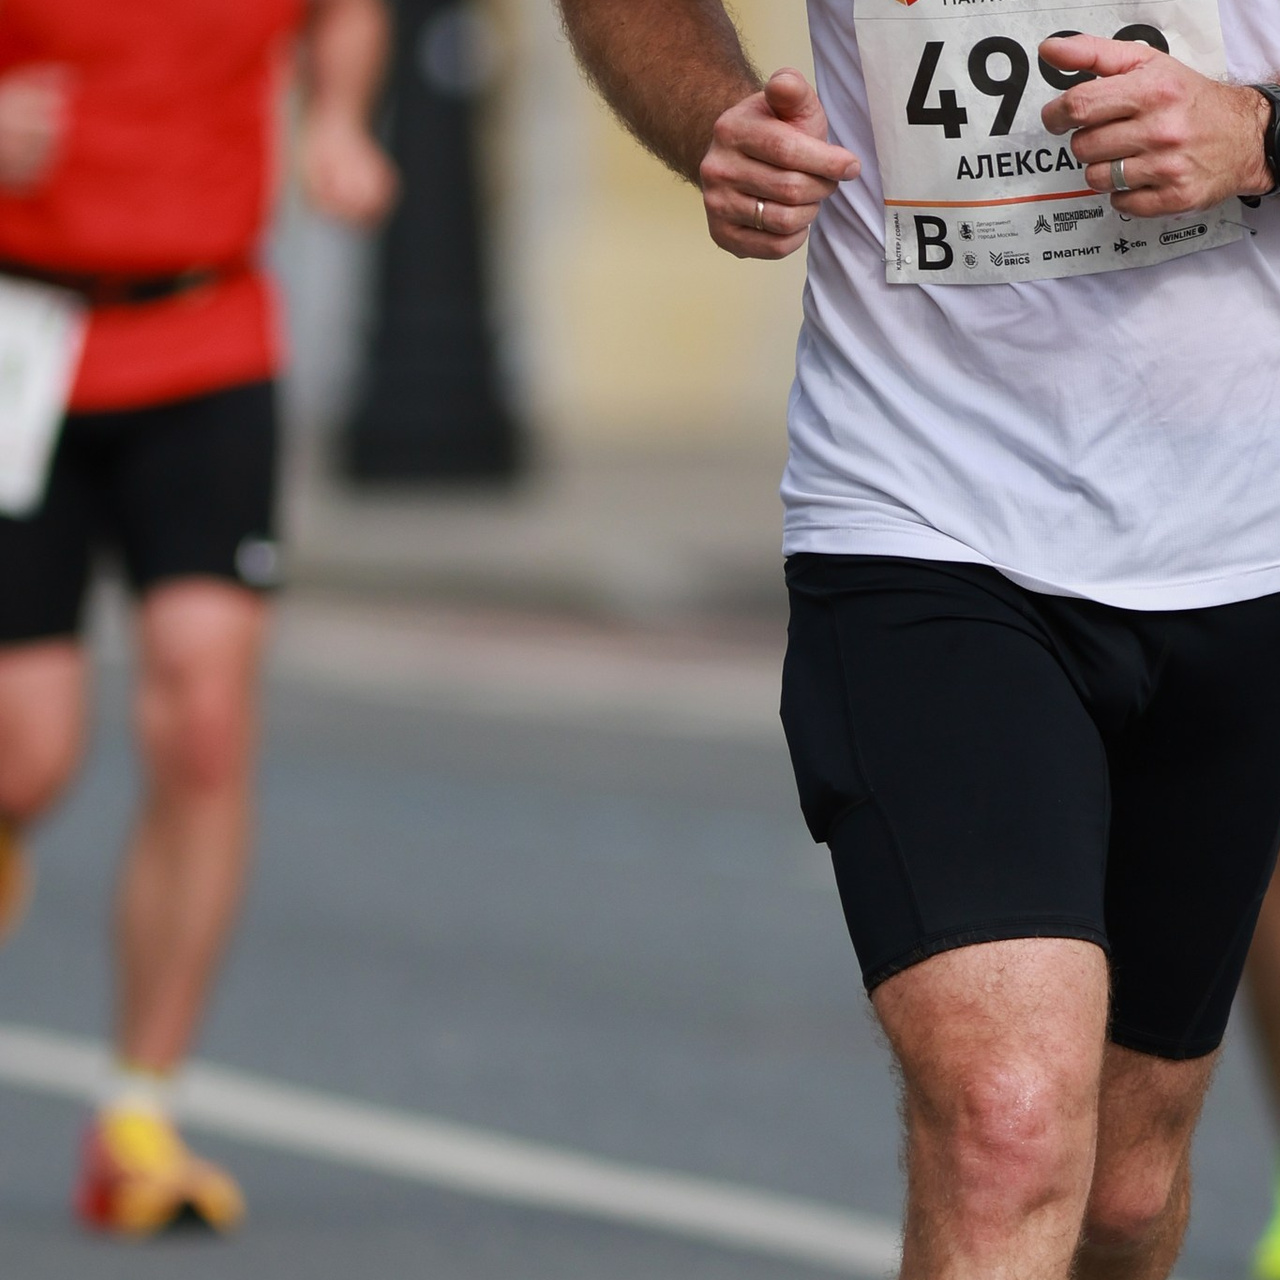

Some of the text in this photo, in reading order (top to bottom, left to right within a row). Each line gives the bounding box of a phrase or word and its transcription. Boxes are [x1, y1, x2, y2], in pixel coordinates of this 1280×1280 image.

[956, 145, 1084, 180] АЛЕКСА
[1053, 206, 1104, 222] МОСКОВСКИЙ
[1054, 221, 1078, 233] СПОРТ
[1163, 228, 1197, 242] WINLINE
[1004, 256, 1030, 266] BRICS
